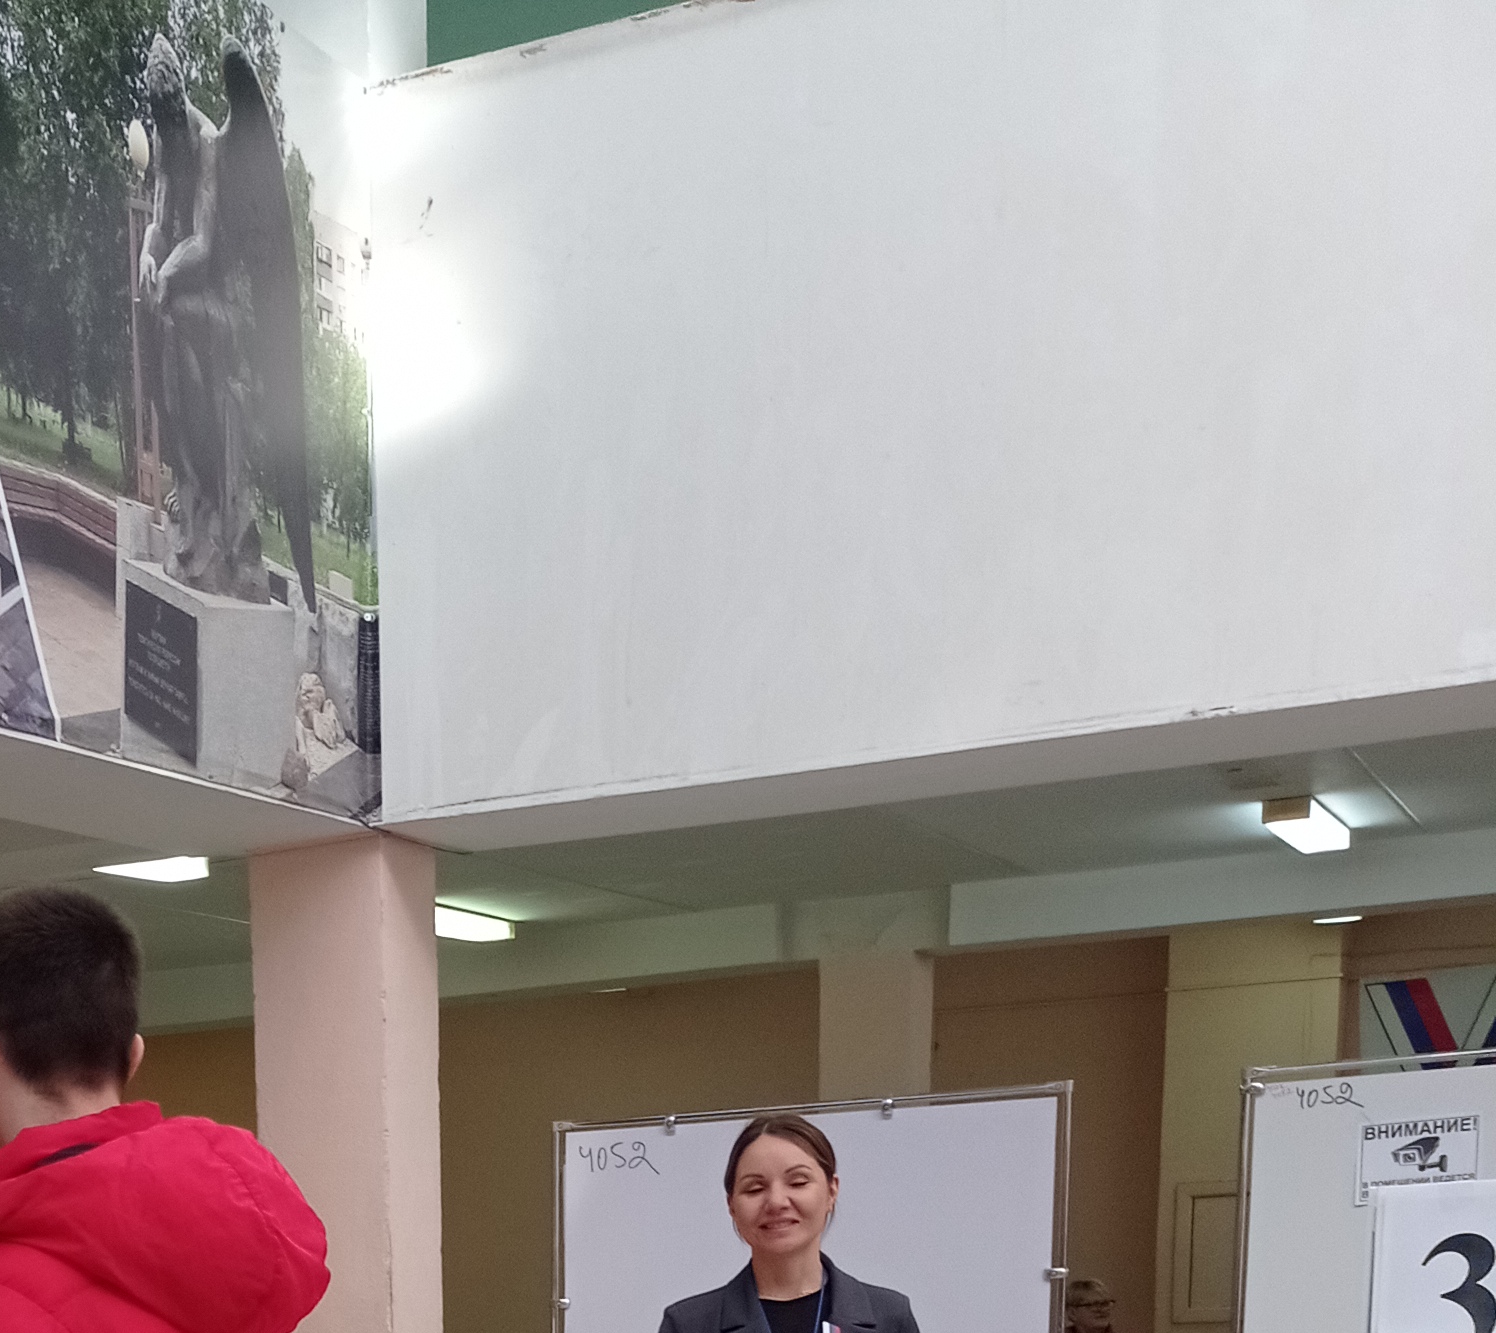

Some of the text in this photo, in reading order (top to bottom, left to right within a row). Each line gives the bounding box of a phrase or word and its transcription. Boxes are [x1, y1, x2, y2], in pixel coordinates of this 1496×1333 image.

[1296, 1082, 1365, 1109] 4052
[1364, 1117, 1479, 1140] ВНИМАНИЕ!
[579, 1141, 661, 1175] 4052
